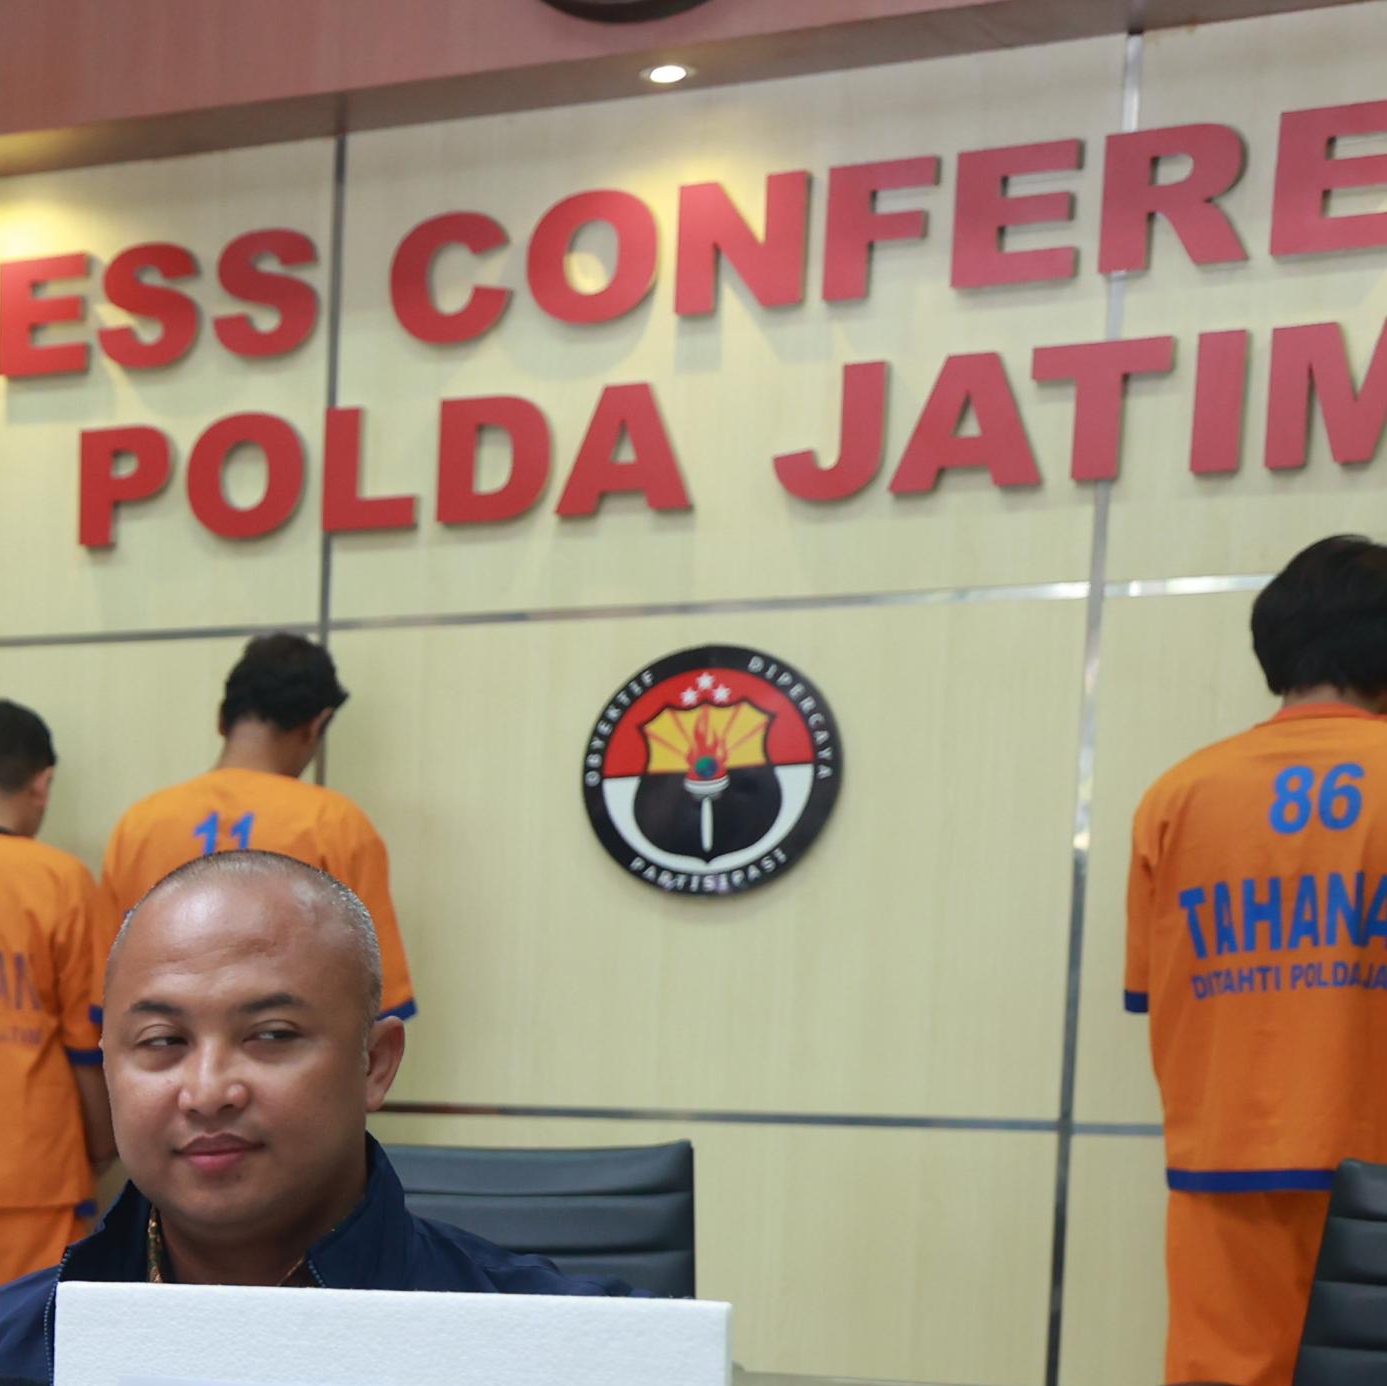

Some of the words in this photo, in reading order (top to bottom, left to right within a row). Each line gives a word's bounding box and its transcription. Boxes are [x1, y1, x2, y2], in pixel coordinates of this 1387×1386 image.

[389, 101, 1387, 345] CONFERE
[78, 383, 693, 549] POLDA
[773, 320, 1387, 503] JATIM
[585, 670, 654, 787] OBYEKTIF
[747, 656, 833, 780] DIPERCAYA
[193, 811, 255, 856] 11
[1268, 762, 1366, 835] 86
[630, 848, 788, 893] PARTISIPASI
[1179, 870, 1387, 959] TAHANA
[1191, 965, 1282, 1001] DITAHTI
